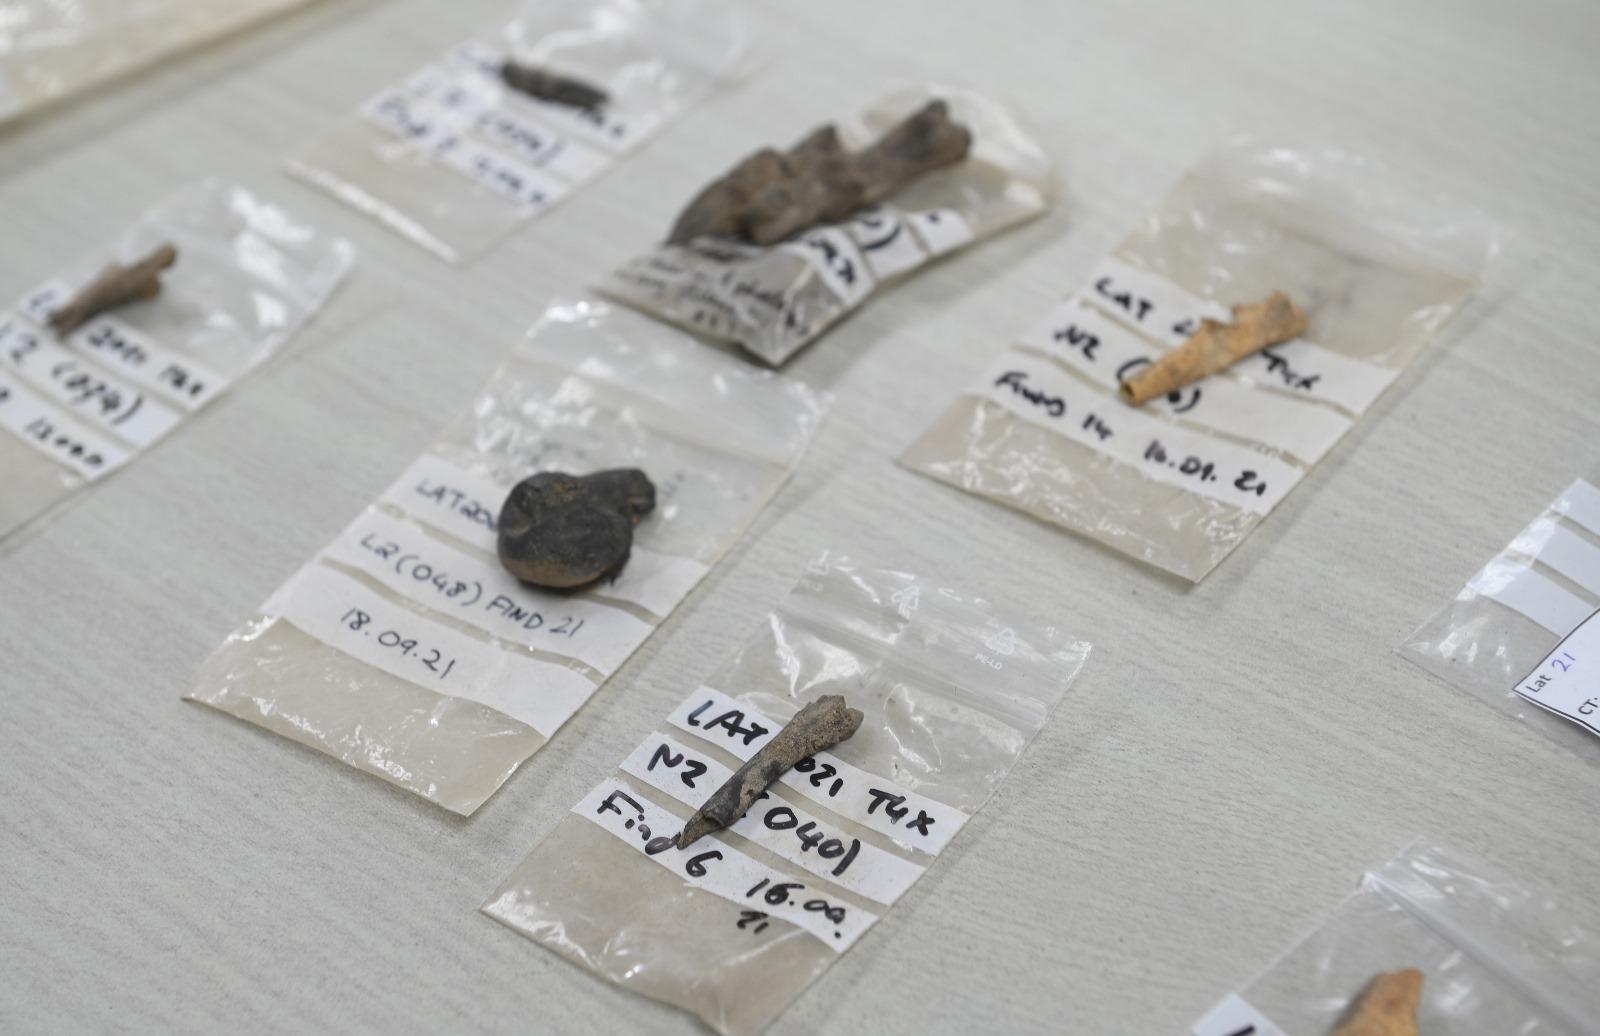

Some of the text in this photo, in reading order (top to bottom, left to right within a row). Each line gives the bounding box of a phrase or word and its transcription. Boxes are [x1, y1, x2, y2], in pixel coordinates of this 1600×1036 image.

[340, 607, 456, 680] 18.09.21
[485, 594, 545, 631] FIND
[549, 616, 585, 638] 21
[1525, 651, 1577, 693] Lat 21
[687, 699, 769, 746] LAT
[793, 756, 844, 798] 021
[596, 789, 682, 856] Find
[685, 849, 723, 878] 6
[741, 791, 861, 877] 040)
